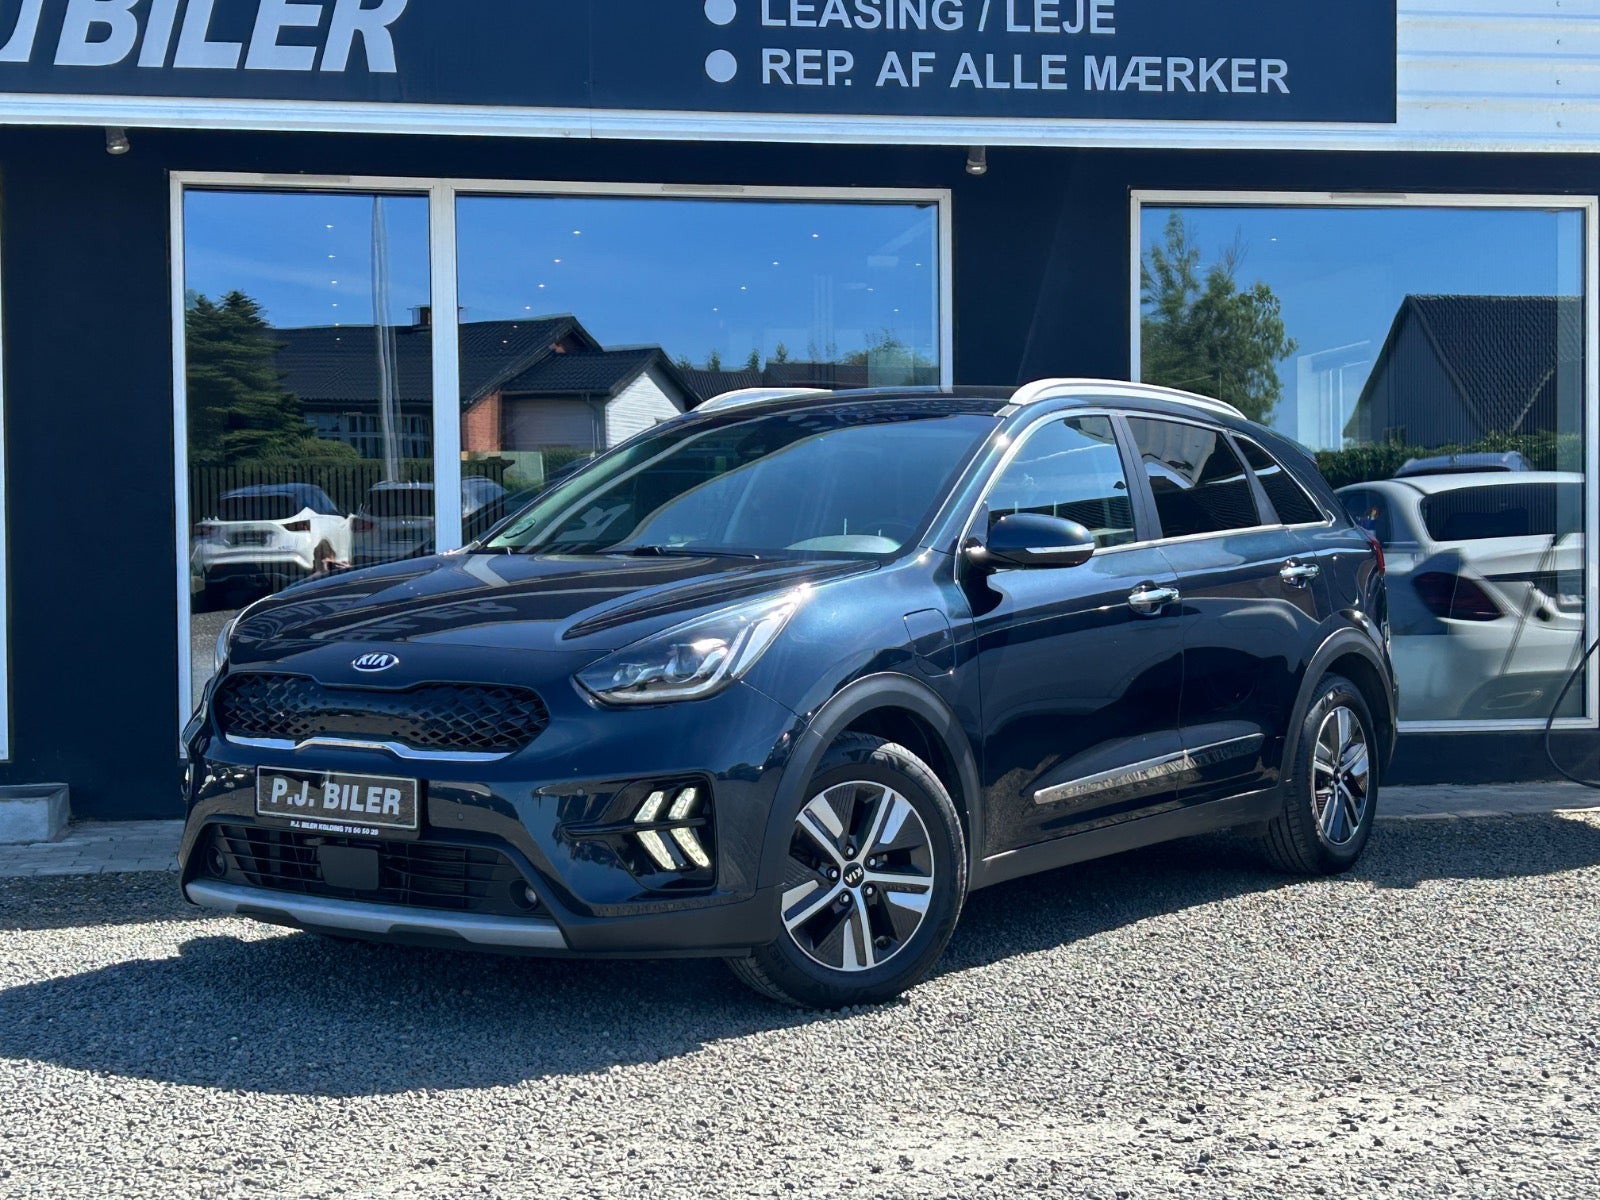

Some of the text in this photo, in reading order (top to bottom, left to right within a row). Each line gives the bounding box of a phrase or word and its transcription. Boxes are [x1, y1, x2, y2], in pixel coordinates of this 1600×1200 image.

[761, 0, 964, 31] LEASING
[1006, 0, 1116, 34] LEJE
[53, 0, 405, 73] BILER
[761, 48, 1290, 94] REP. AF ALLE MÆRKER
[356, 653, 389, 666] KIA
[271, 777, 402, 816] P.J. BILER
[845, 867, 863, 883] KIA
